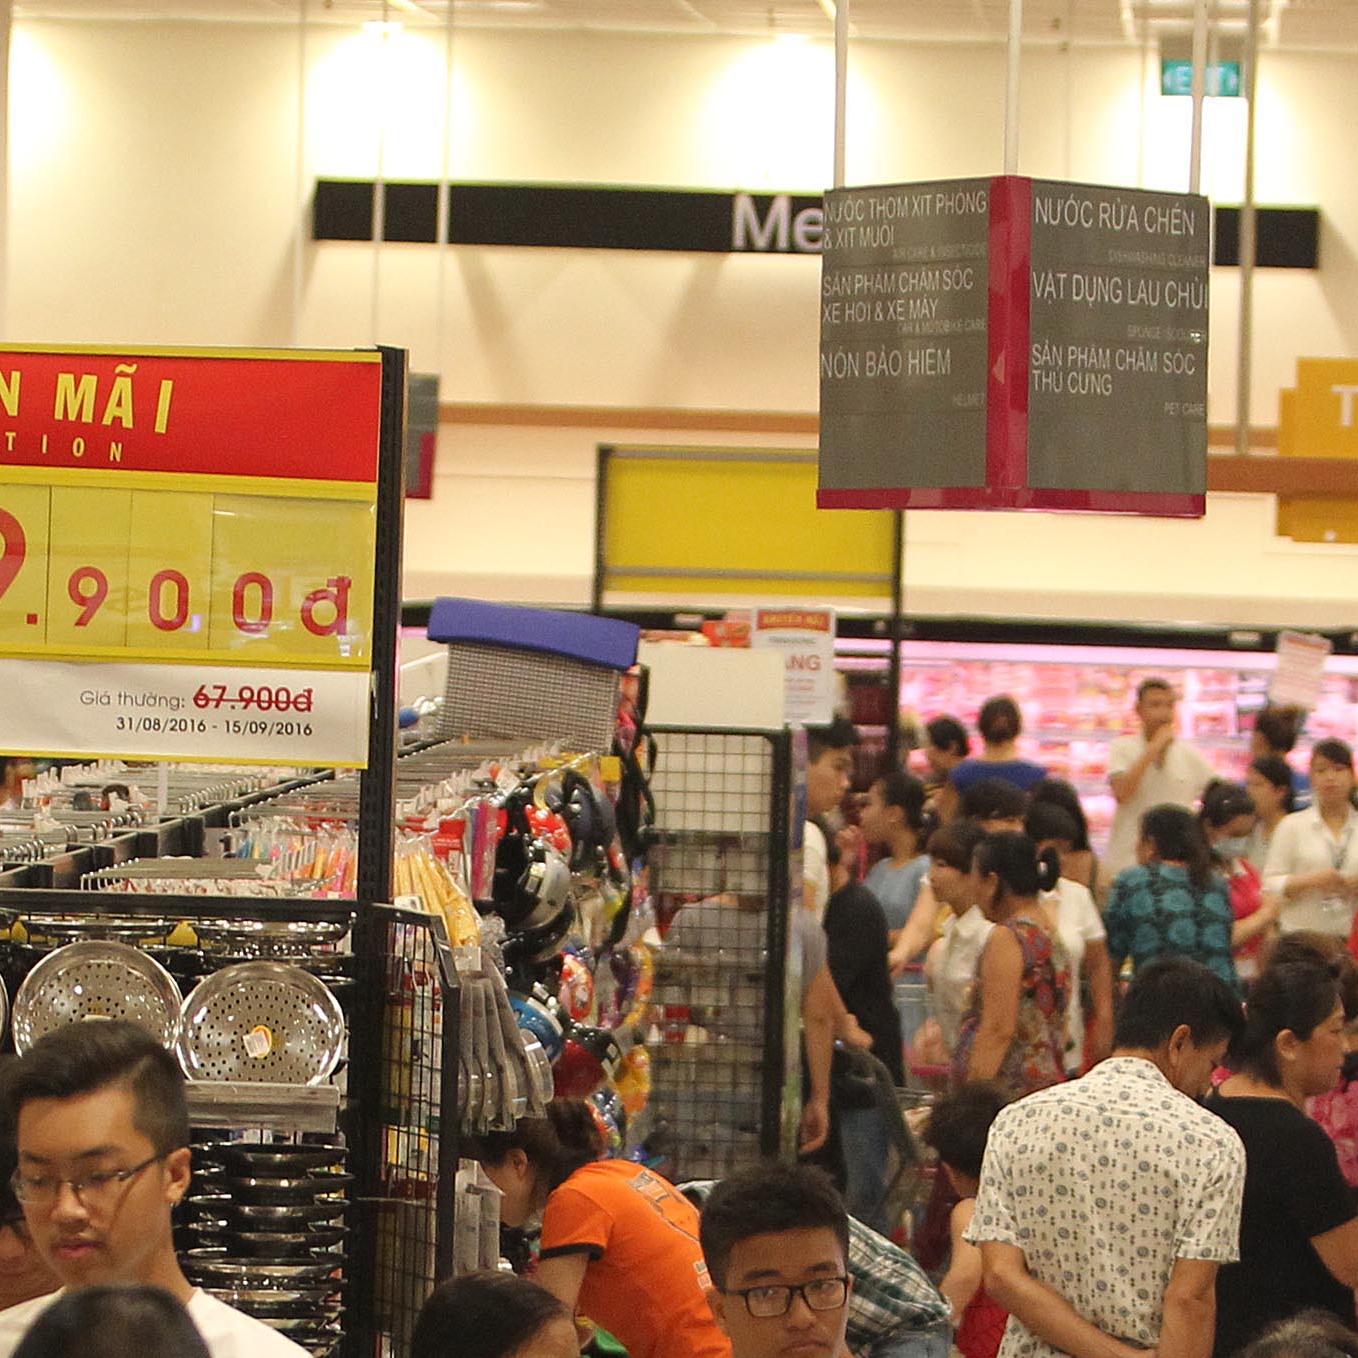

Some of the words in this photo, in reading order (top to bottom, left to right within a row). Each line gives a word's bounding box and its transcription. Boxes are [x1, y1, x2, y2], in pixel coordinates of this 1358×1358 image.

[1034, 193, 1094, 228] NƯỚC
[1098, 197, 1139, 232] RỬA
[1144, 202, 1195, 236] CHÉN
[941, 264, 974, 291] SÓC
[1072, 273, 1123, 309] DỤNG
[1127, 278, 1161, 306] LAU
[822, 302, 841, 324] XE
[874, 300, 884, 322] &
[886, 299, 905, 321] XE
[908, 294, 939, 320] MÁY
[821, 345, 860, 379] NÓN
[865, 344, 903, 376] BẢO
[1032, 339, 1063, 368] SẢN
[1162, 347, 1196, 376] SÓC
[1032, 365, 1064, 394] THÚ
[53, 362, 174, 435] MÃI
[79, 690, 112, 706] Giá
[117, 690, 186, 711] thường:
[192, 684, 314, 713] 67.900đ
[116, 716, 207, 733] 31/08/2016
[224, 719, 313, 737] 15/09/2016
